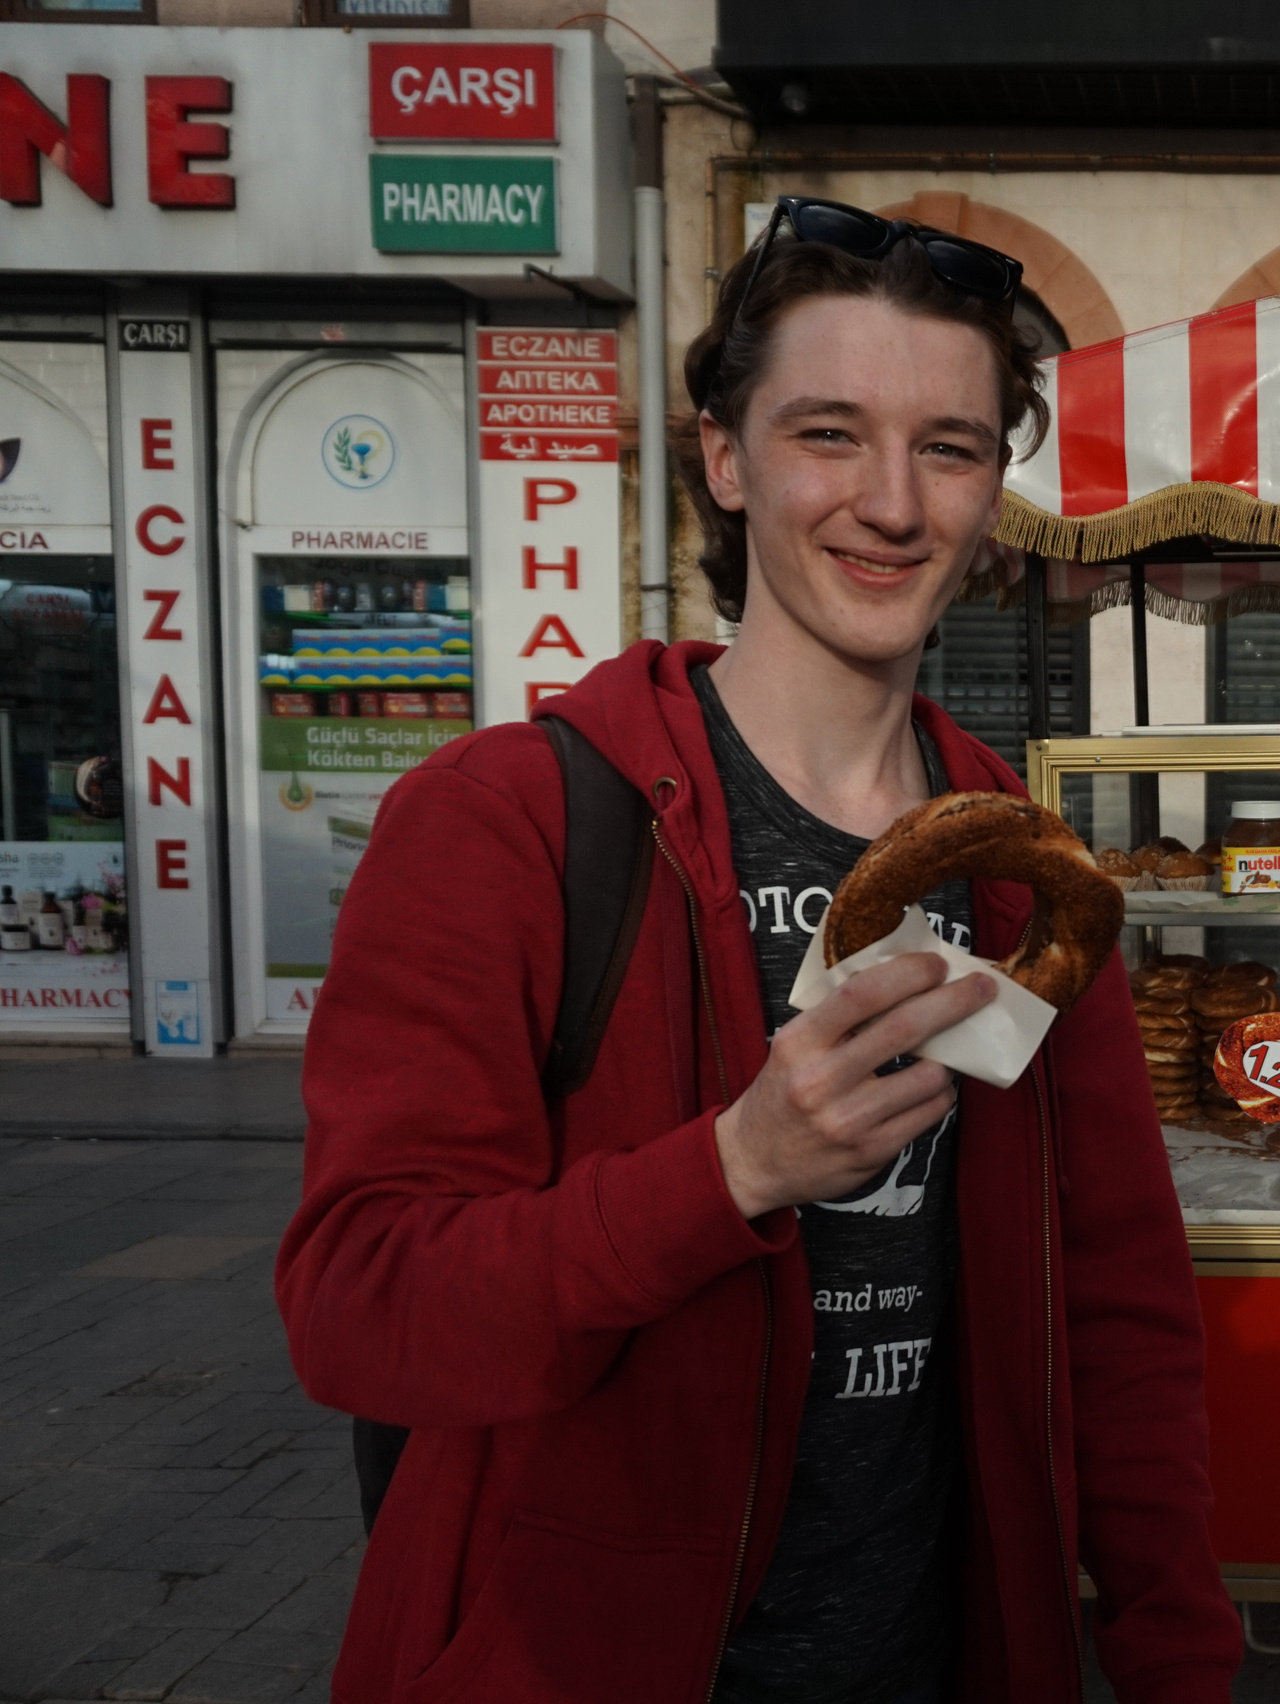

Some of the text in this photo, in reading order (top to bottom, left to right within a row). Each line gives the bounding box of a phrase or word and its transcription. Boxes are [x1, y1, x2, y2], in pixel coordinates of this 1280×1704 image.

[391, 65, 536, 115] ÇARŞI
[383, 182, 544, 223] PHARMACY
[123, 322, 185, 348] ÇARŞI
[491, 335, 601, 358] ECZANE
[487, 403, 611, 424] APOTHEKE
[291, 531, 429, 550] PHARMACIE
[306, 726, 360, 748] Güçlü
[364, 727, 424, 749] Saçlar
[307, 749, 376, 767] Kökten
[812, 1283, 873, 1312] and
